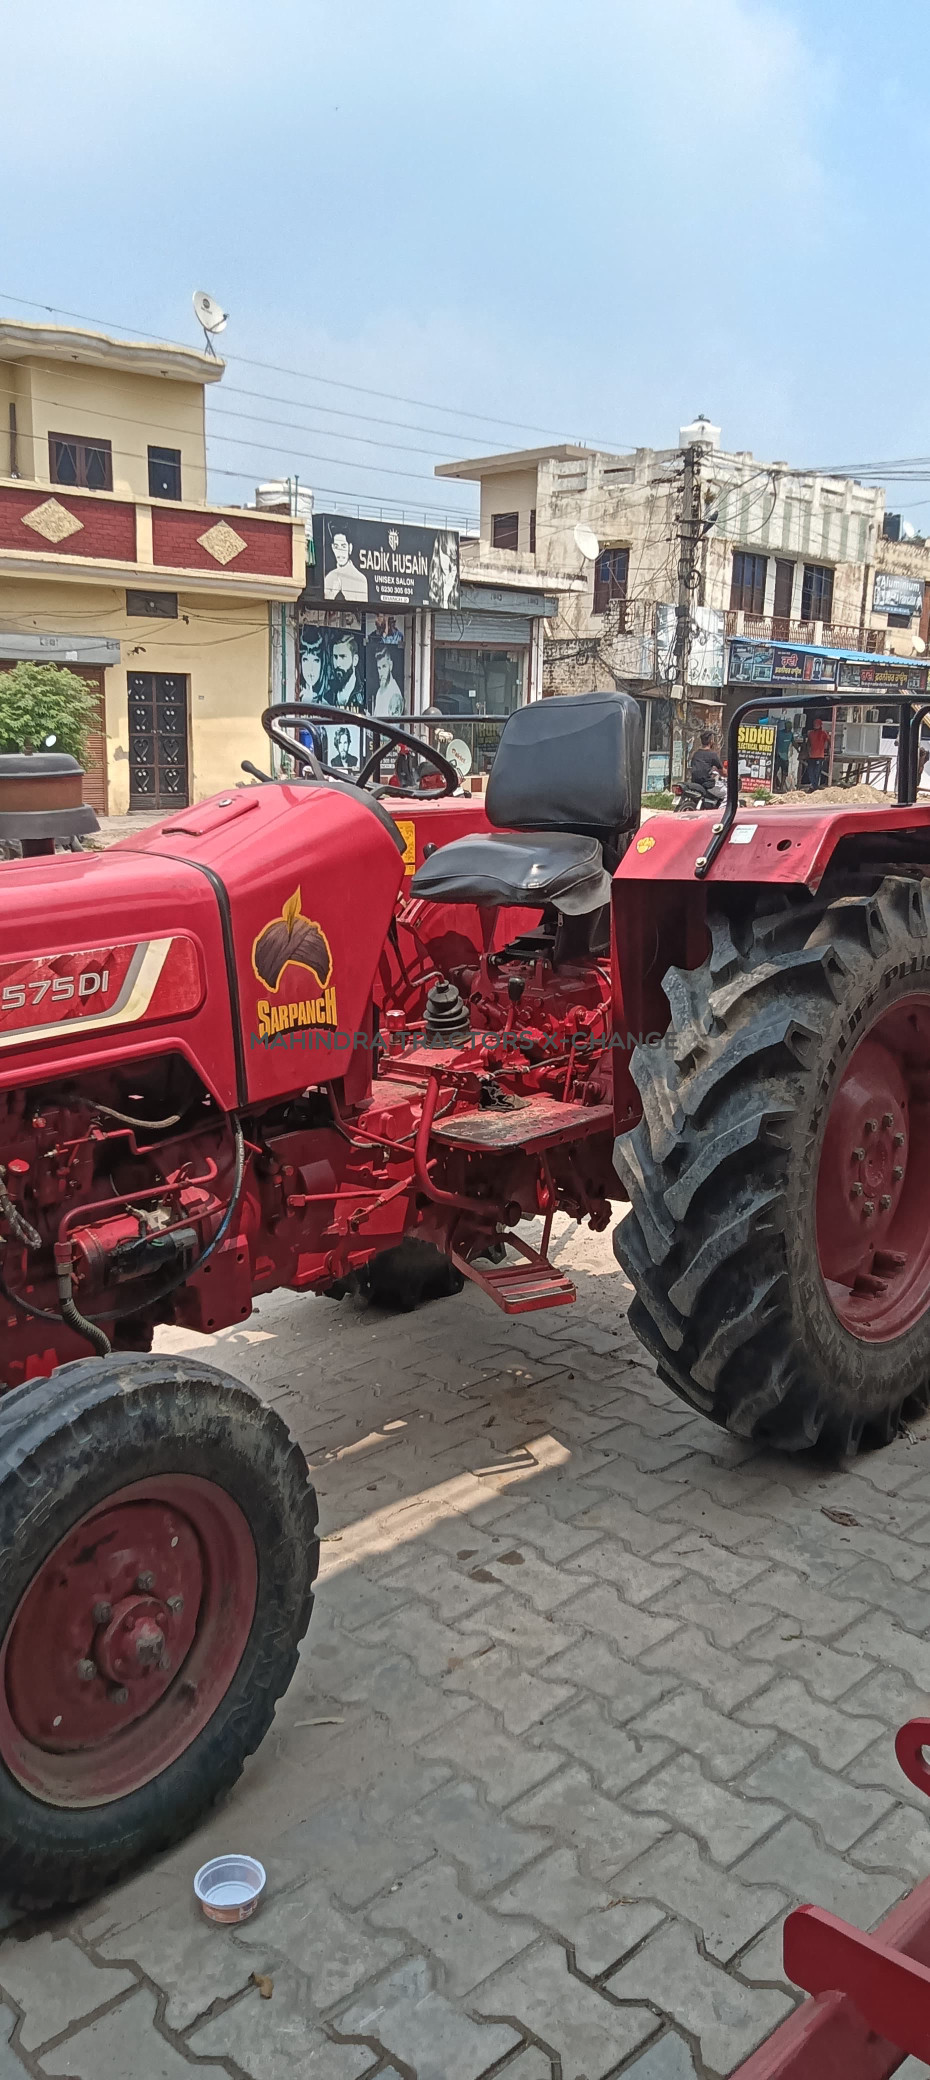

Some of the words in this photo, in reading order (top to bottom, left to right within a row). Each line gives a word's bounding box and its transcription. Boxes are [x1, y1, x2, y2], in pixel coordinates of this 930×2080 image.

[374, 575, 395, 584] UNISEX
[396, 577, 415, 586] SALON
[880, 576, 920, 592] Aluminium
[738, 727, 774, 745] SIDHU
[257, 986, 338, 1038] SARPANCH
